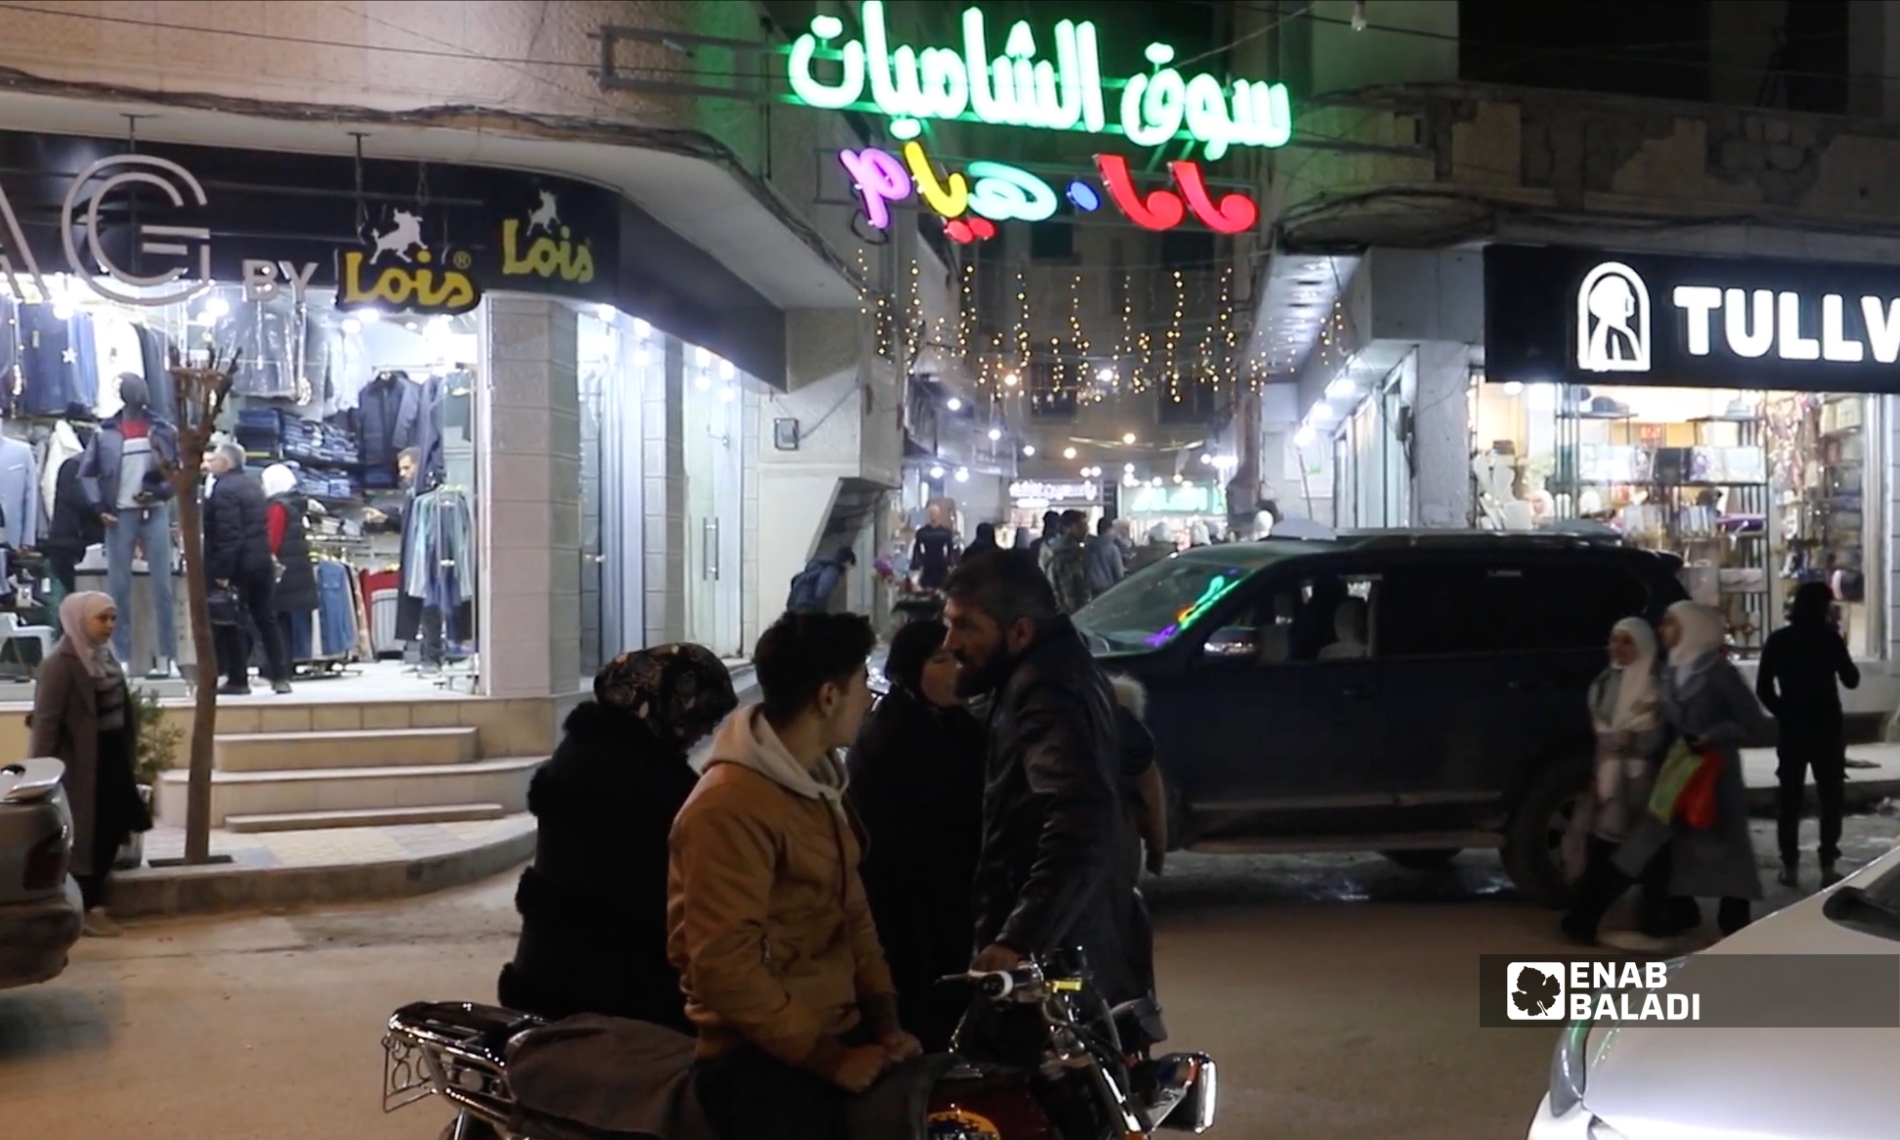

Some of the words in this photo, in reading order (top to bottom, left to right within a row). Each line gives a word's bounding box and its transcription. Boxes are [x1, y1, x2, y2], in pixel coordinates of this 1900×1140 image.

[788, 0, 1104, 140] الشاميات
[1120, 42, 1292, 160] سوق
[1093, 153, 1258, 234] ماما
[242, 259, 319, 302] BY
[502, 219, 595, 283] Lois
